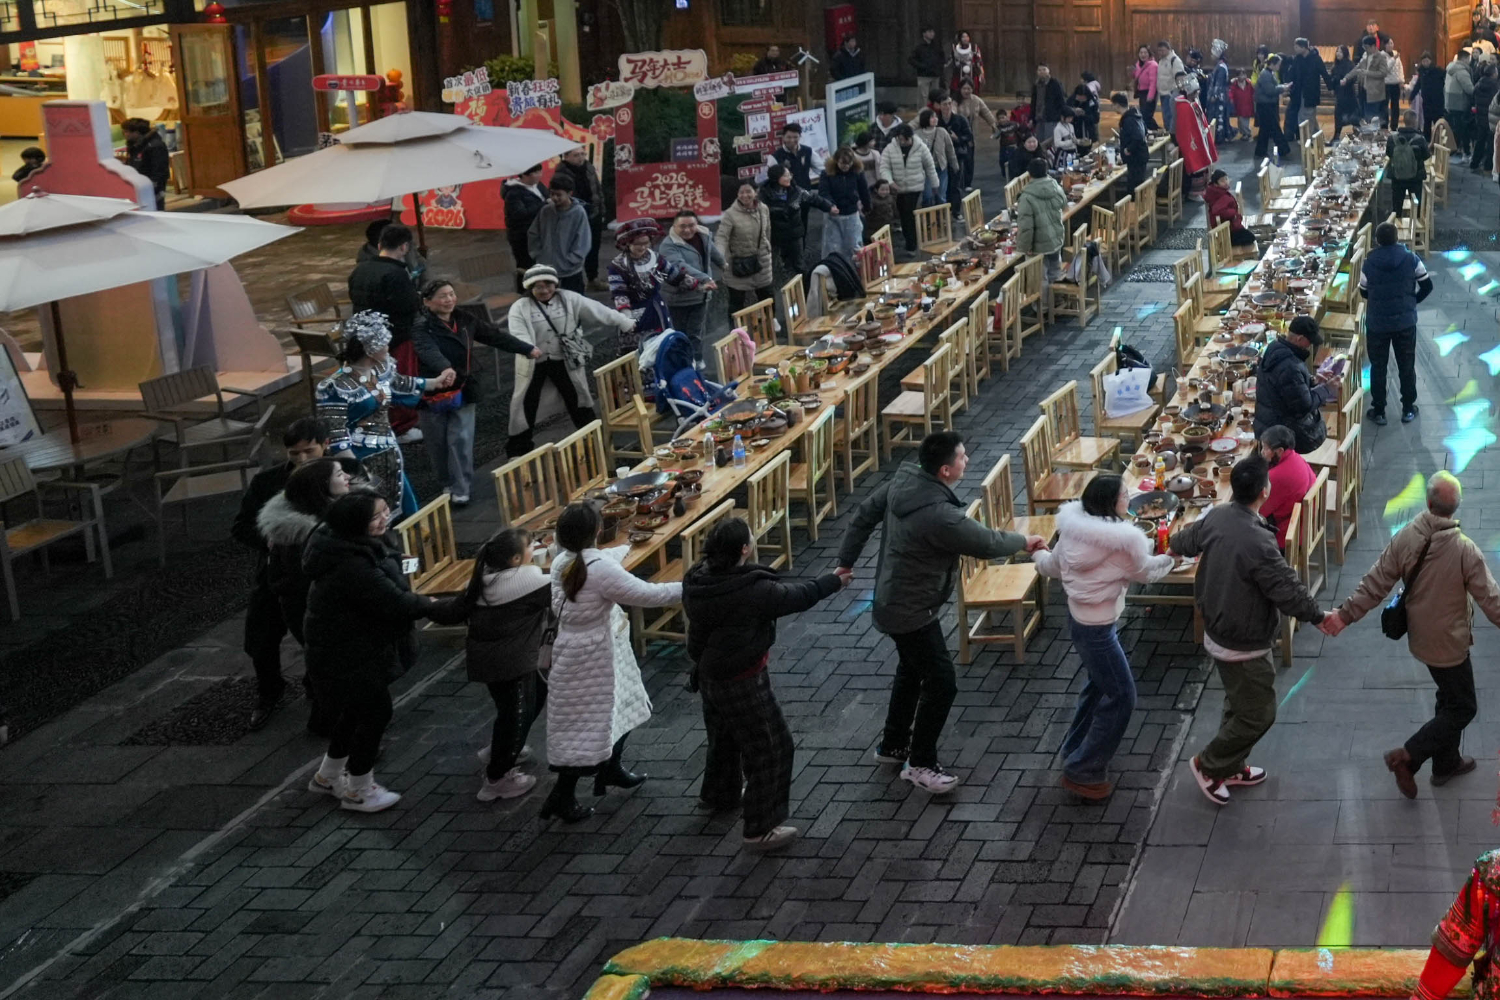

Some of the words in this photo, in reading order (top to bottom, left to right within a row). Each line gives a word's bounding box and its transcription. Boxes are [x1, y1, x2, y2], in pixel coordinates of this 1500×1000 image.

[445, 68, 488, 88] 首次最低
[624, 55, 691, 83] 马年大吉
[508, 80, 558, 97] 新春狂欢
[511, 93, 560, 117] 贵旅有礼
[652, 172, 688, 185] 2026
[629, 184, 711, 212] 马上有钱
[424, 207, 465, 229] 2026
